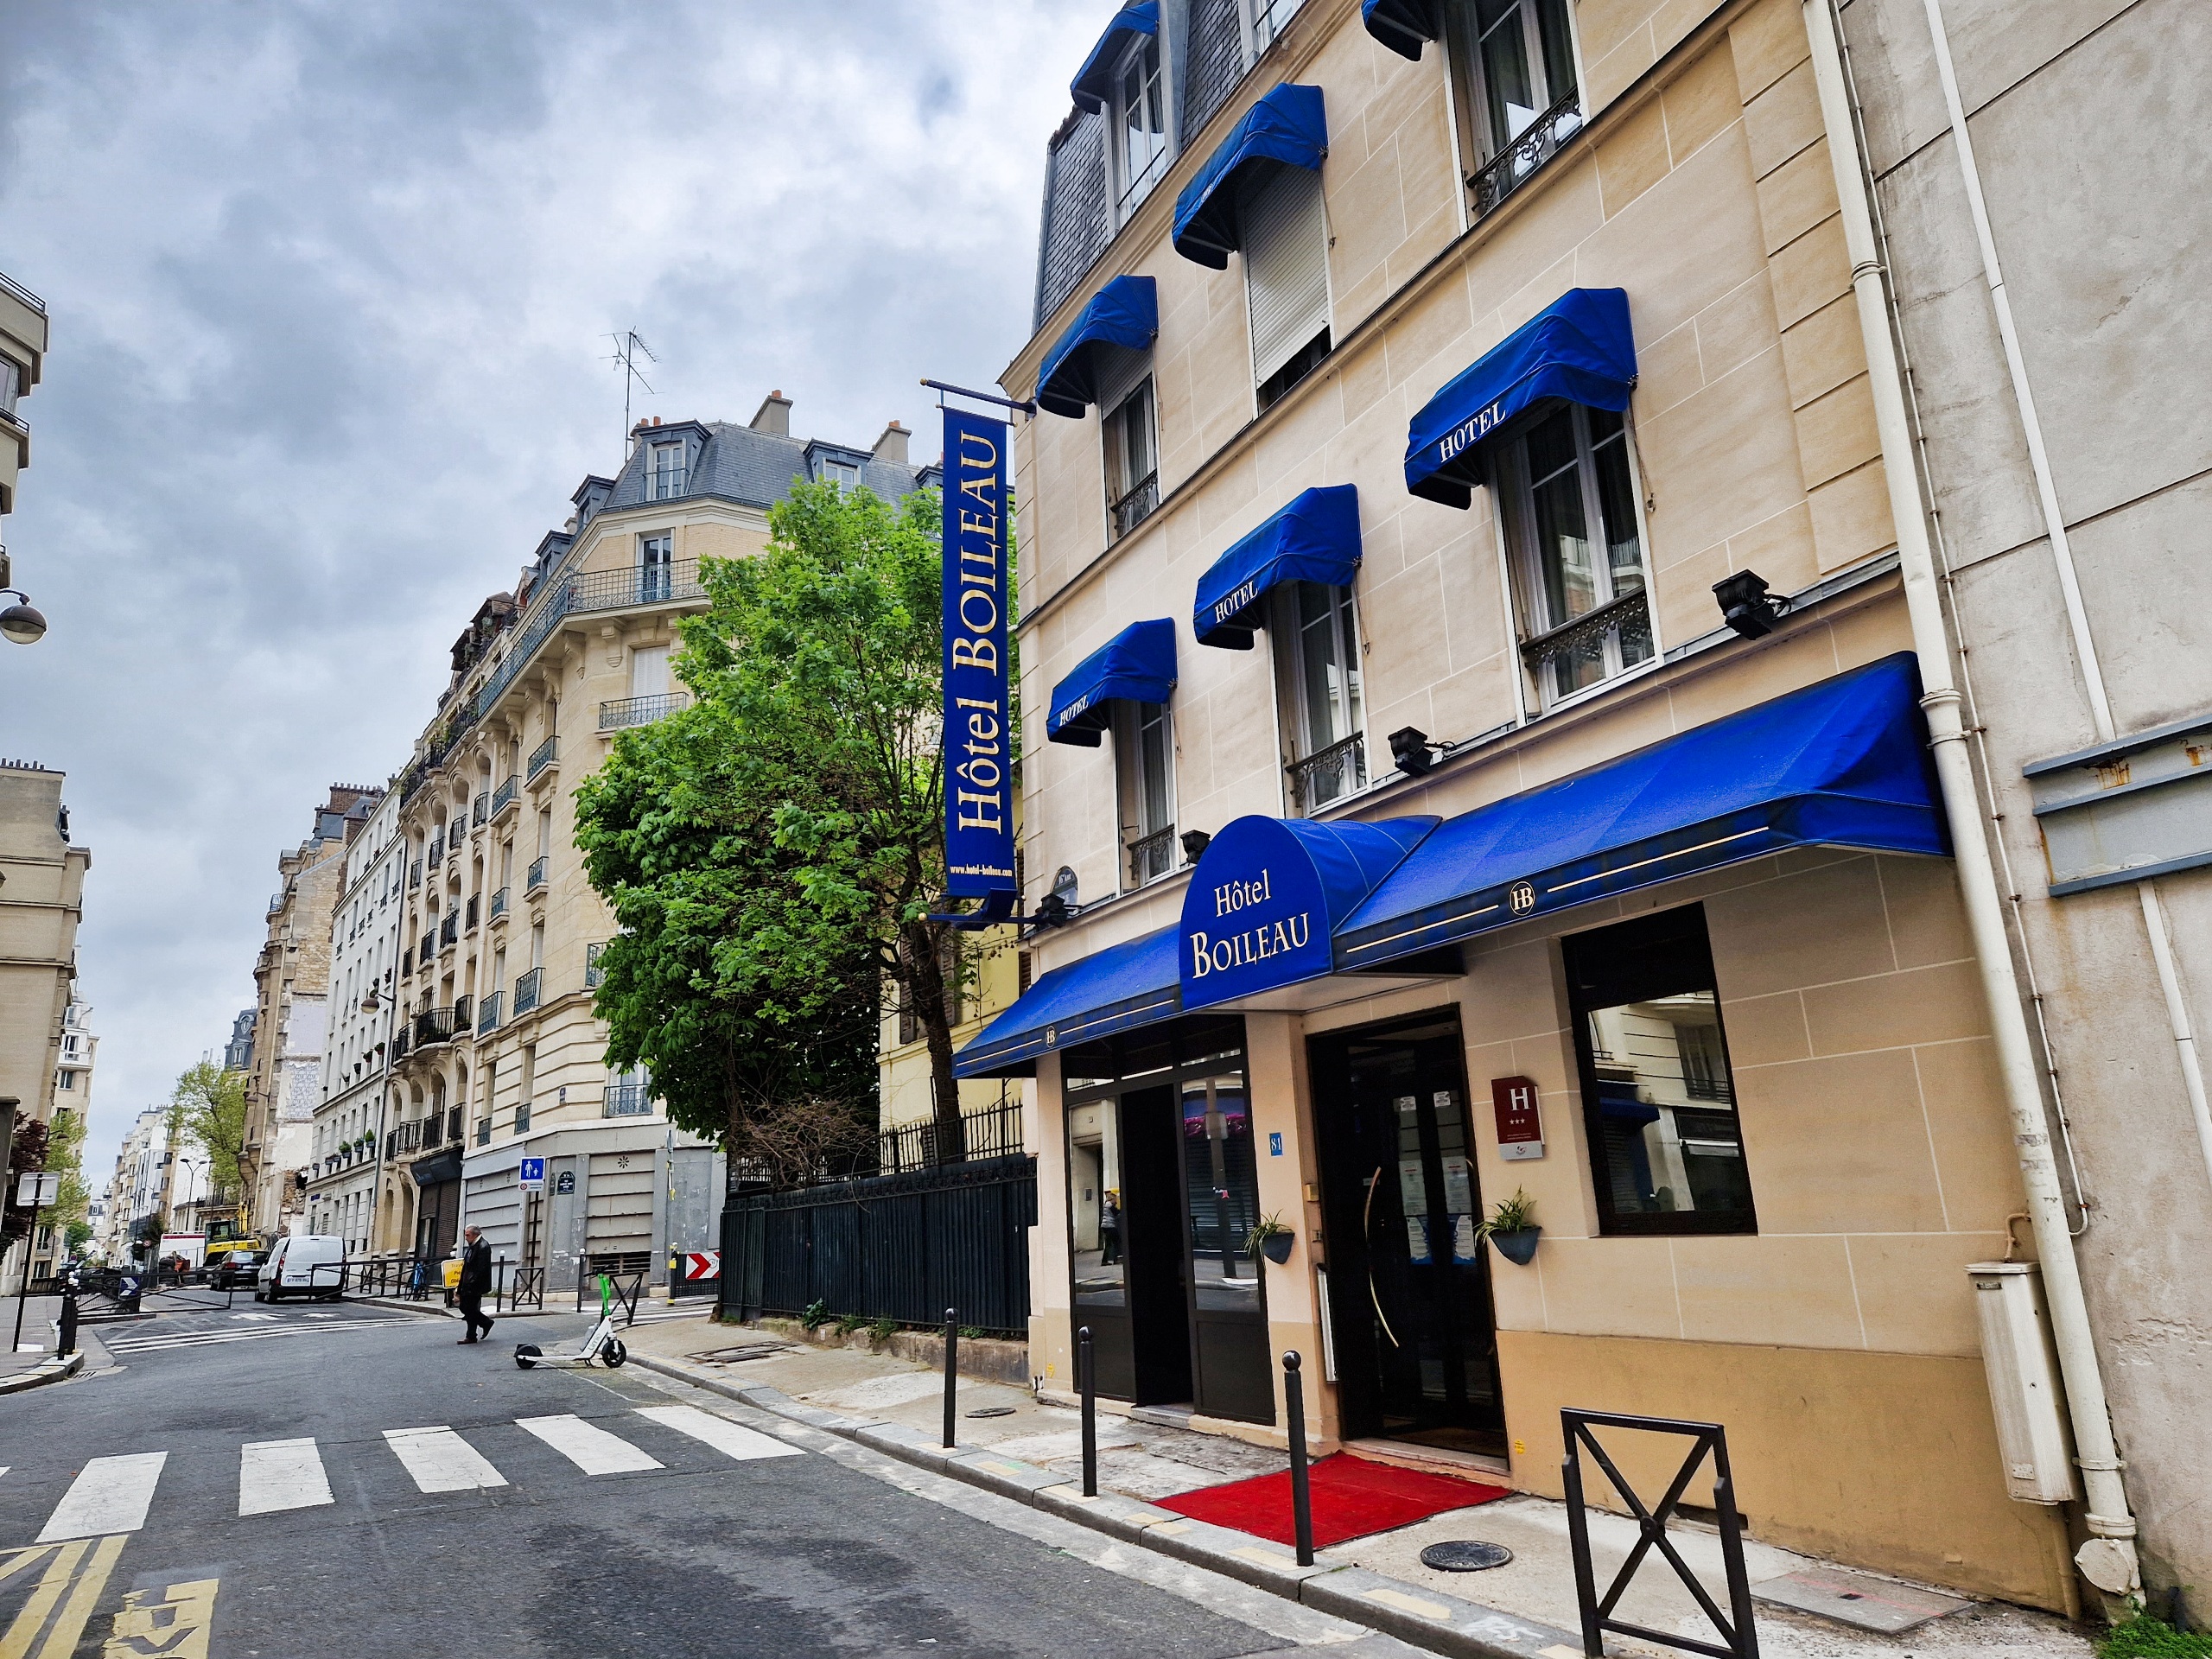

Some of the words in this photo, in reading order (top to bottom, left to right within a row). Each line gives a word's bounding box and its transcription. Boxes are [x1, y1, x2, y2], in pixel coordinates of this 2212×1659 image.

[1439, 401, 1506, 463] HOTEL
[952, 429, 999, 677] BOILEAU
[1214, 581, 1258, 624] HOTEL
[1058, 694, 1089, 727] HOTEL
[957, 696, 1002, 835] Hôtel
[1214, 868, 1271, 918] Hôtel
[1512, 887, 1534, 911] HB
[1190, 912, 1310, 980] BOILEAU
[1509, 1086, 1531, 1111] H
